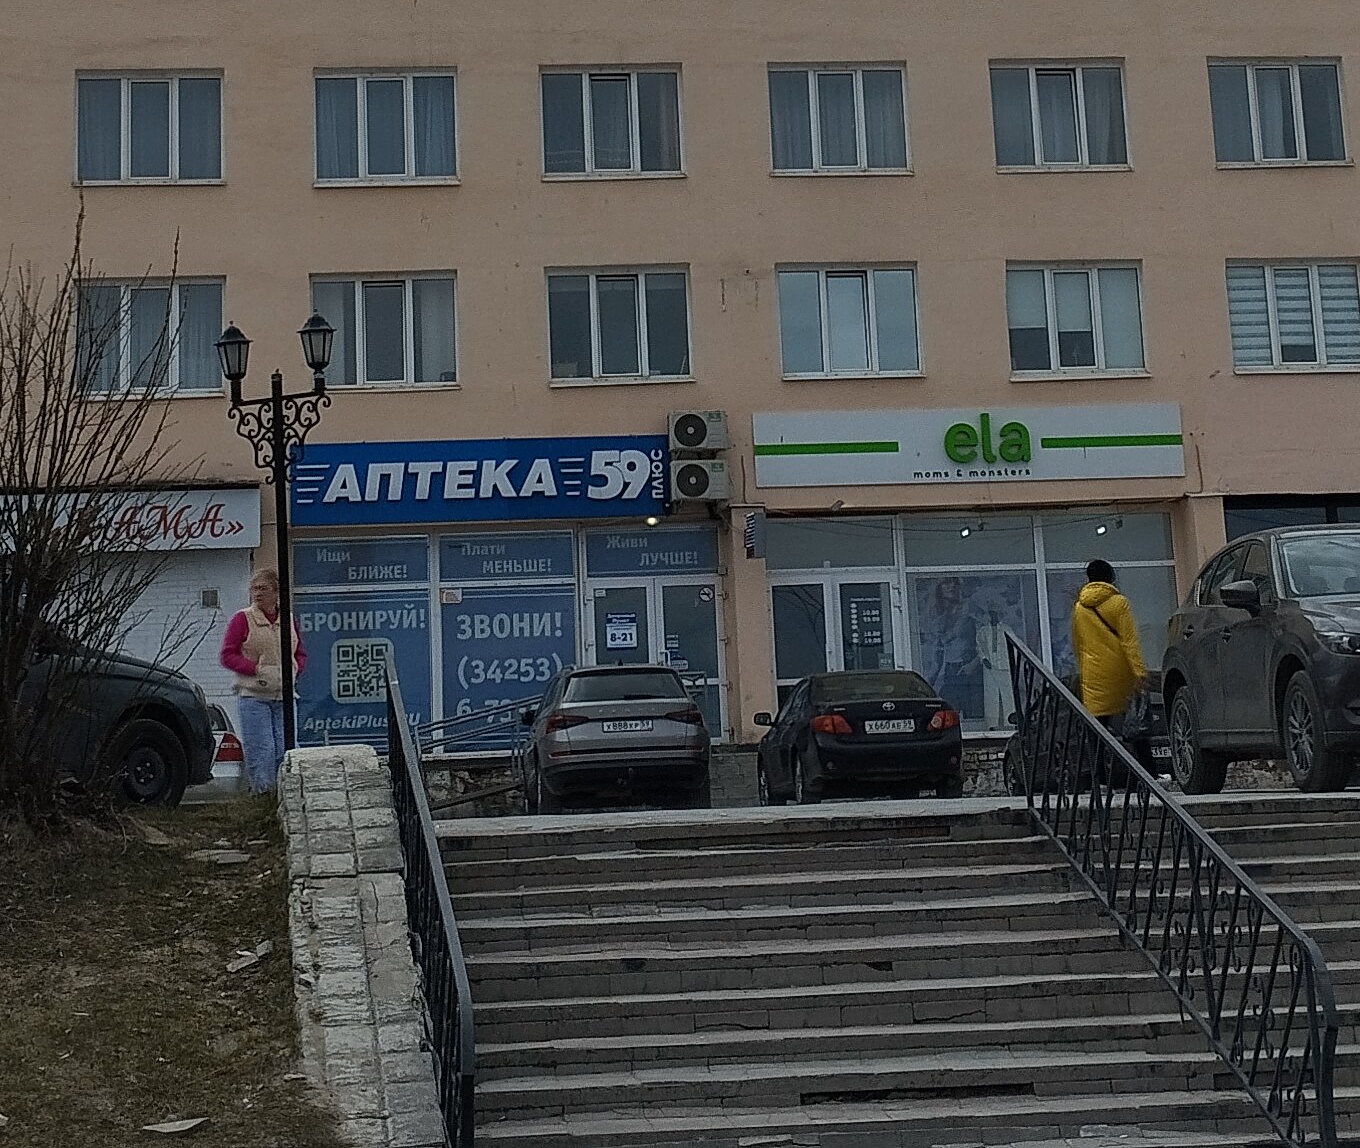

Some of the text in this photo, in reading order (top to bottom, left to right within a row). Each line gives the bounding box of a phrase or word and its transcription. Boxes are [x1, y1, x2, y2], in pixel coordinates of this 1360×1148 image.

[943, 412, 1031, 464] ela
[323, 458, 558, 503] АПТЕКА
[587, 450, 652, 500] 59
[650, 448, 665, 500] ПЛЮС
[913, 470, 950, 479] moms
[969, 467, 1031, 478] monsters
[461, 543, 506, 556] Плати
[607, 535, 648, 550] Живи
[316, 548, 351, 563] Ищи
[640, 551, 699, 566] ЛУЧШЕ!
[347, 564, 408, 580] БЛИЖЕ!
[482, 559, 552, 574] МЕНЬШЕ!
[300, 603, 427, 632] БРОНИРУЙ!
[456, 612, 563, 640] ЗВОНИ!
[610, 632, 633, 643] 8-21
[457, 652, 563, 690] (34253)
